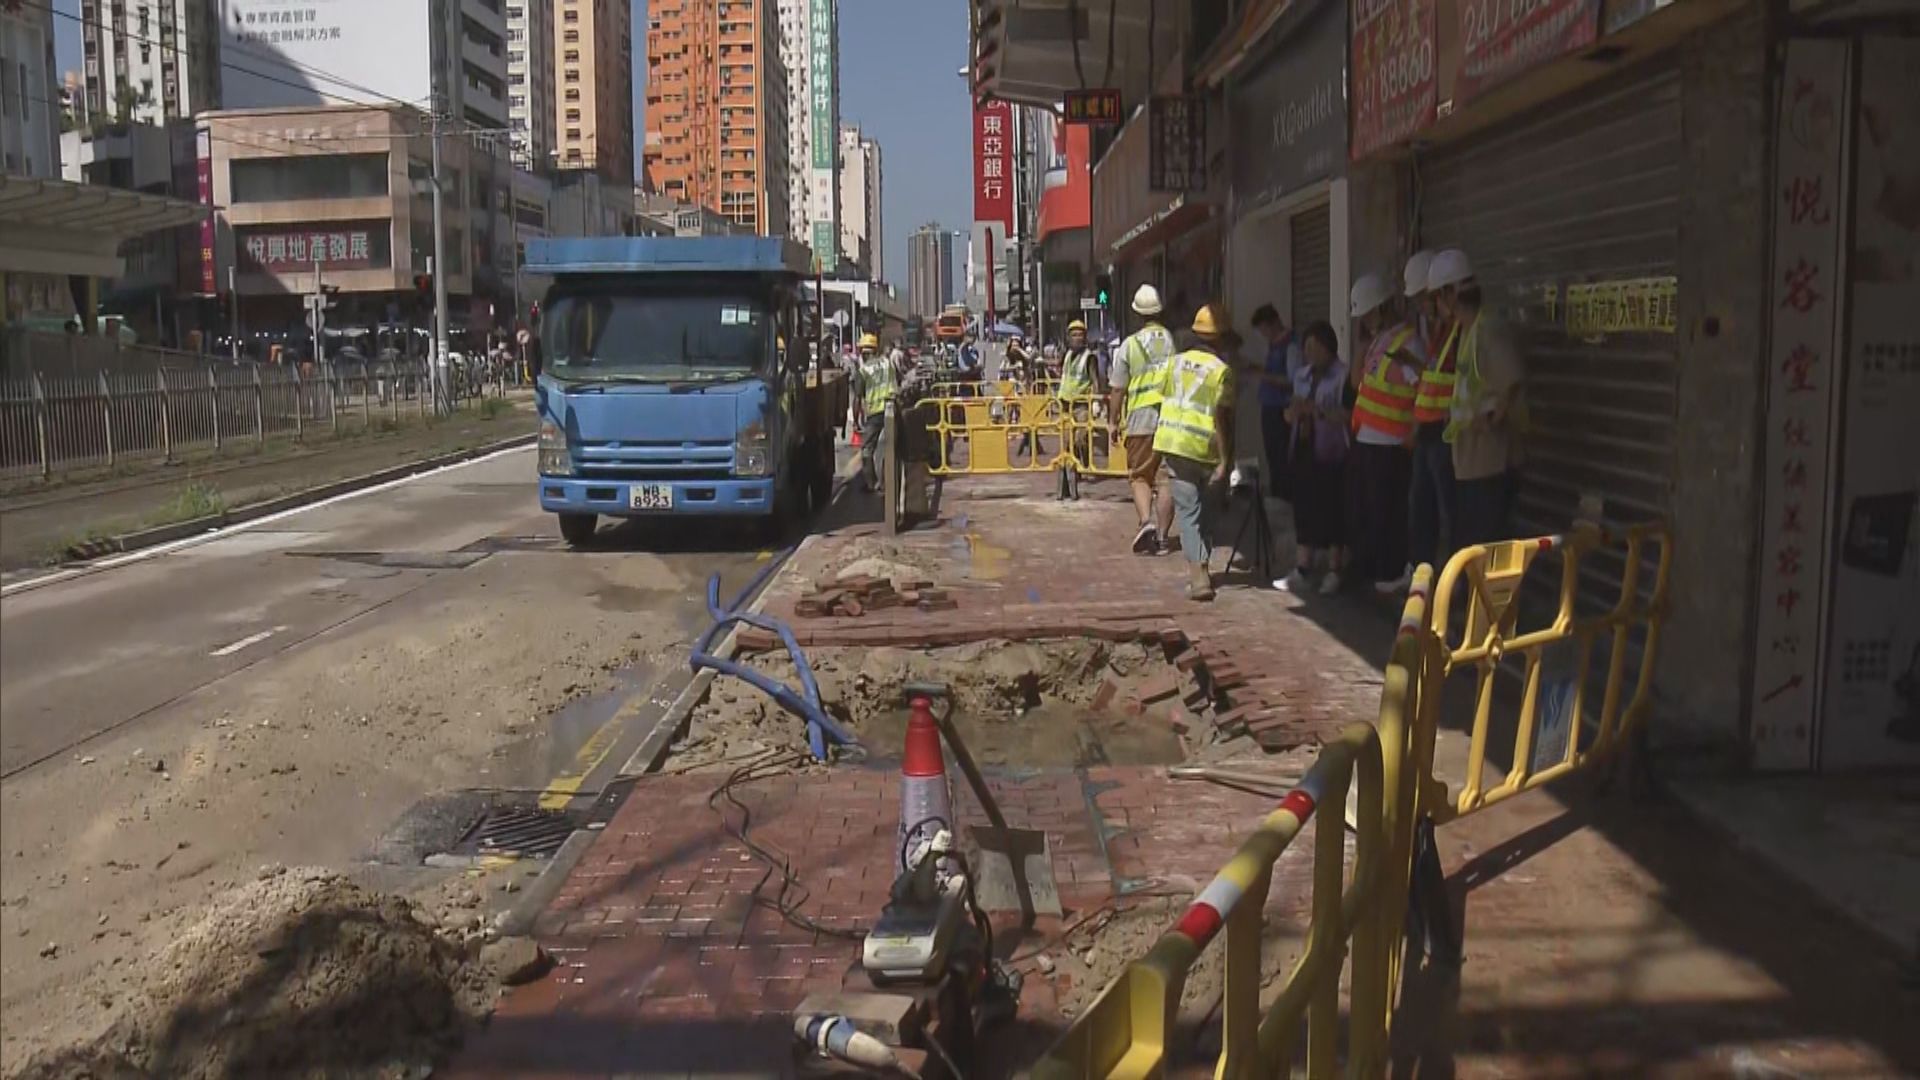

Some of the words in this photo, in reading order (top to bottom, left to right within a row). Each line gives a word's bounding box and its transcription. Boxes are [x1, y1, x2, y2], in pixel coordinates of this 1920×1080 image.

[983, 115, 1003, 199] 東亞銀行
[634, 496, 669, 508] 8923
